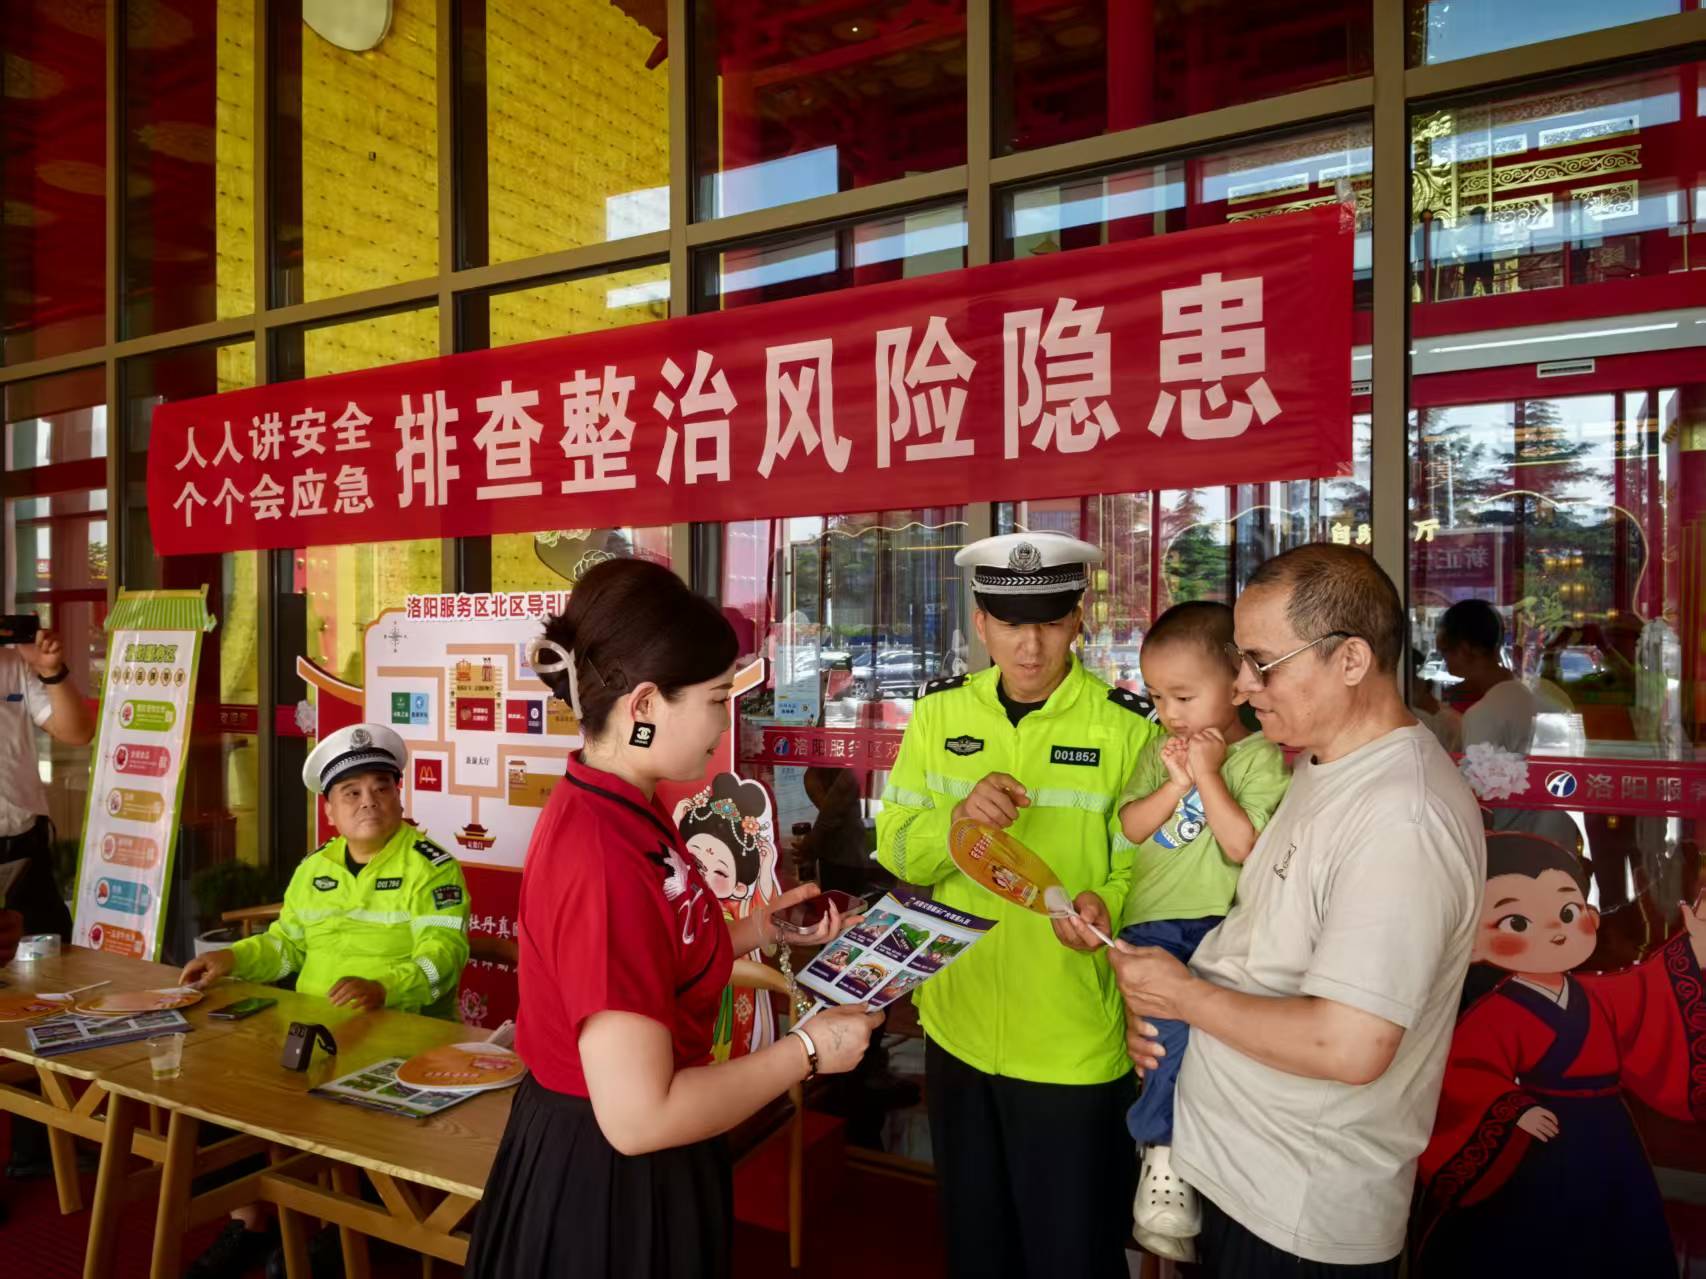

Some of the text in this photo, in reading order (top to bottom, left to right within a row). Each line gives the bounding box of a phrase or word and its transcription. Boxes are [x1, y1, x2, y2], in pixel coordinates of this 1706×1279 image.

[394, 271, 1283, 509] 排查整治风险隐患
[174, 401, 374, 471] 人人讲安全
[173, 464, 374, 528] 个个会应急
[407, 594, 572, 619] 洛阳服务区北区导引
[1054, 749, 1097, 763] 001852
